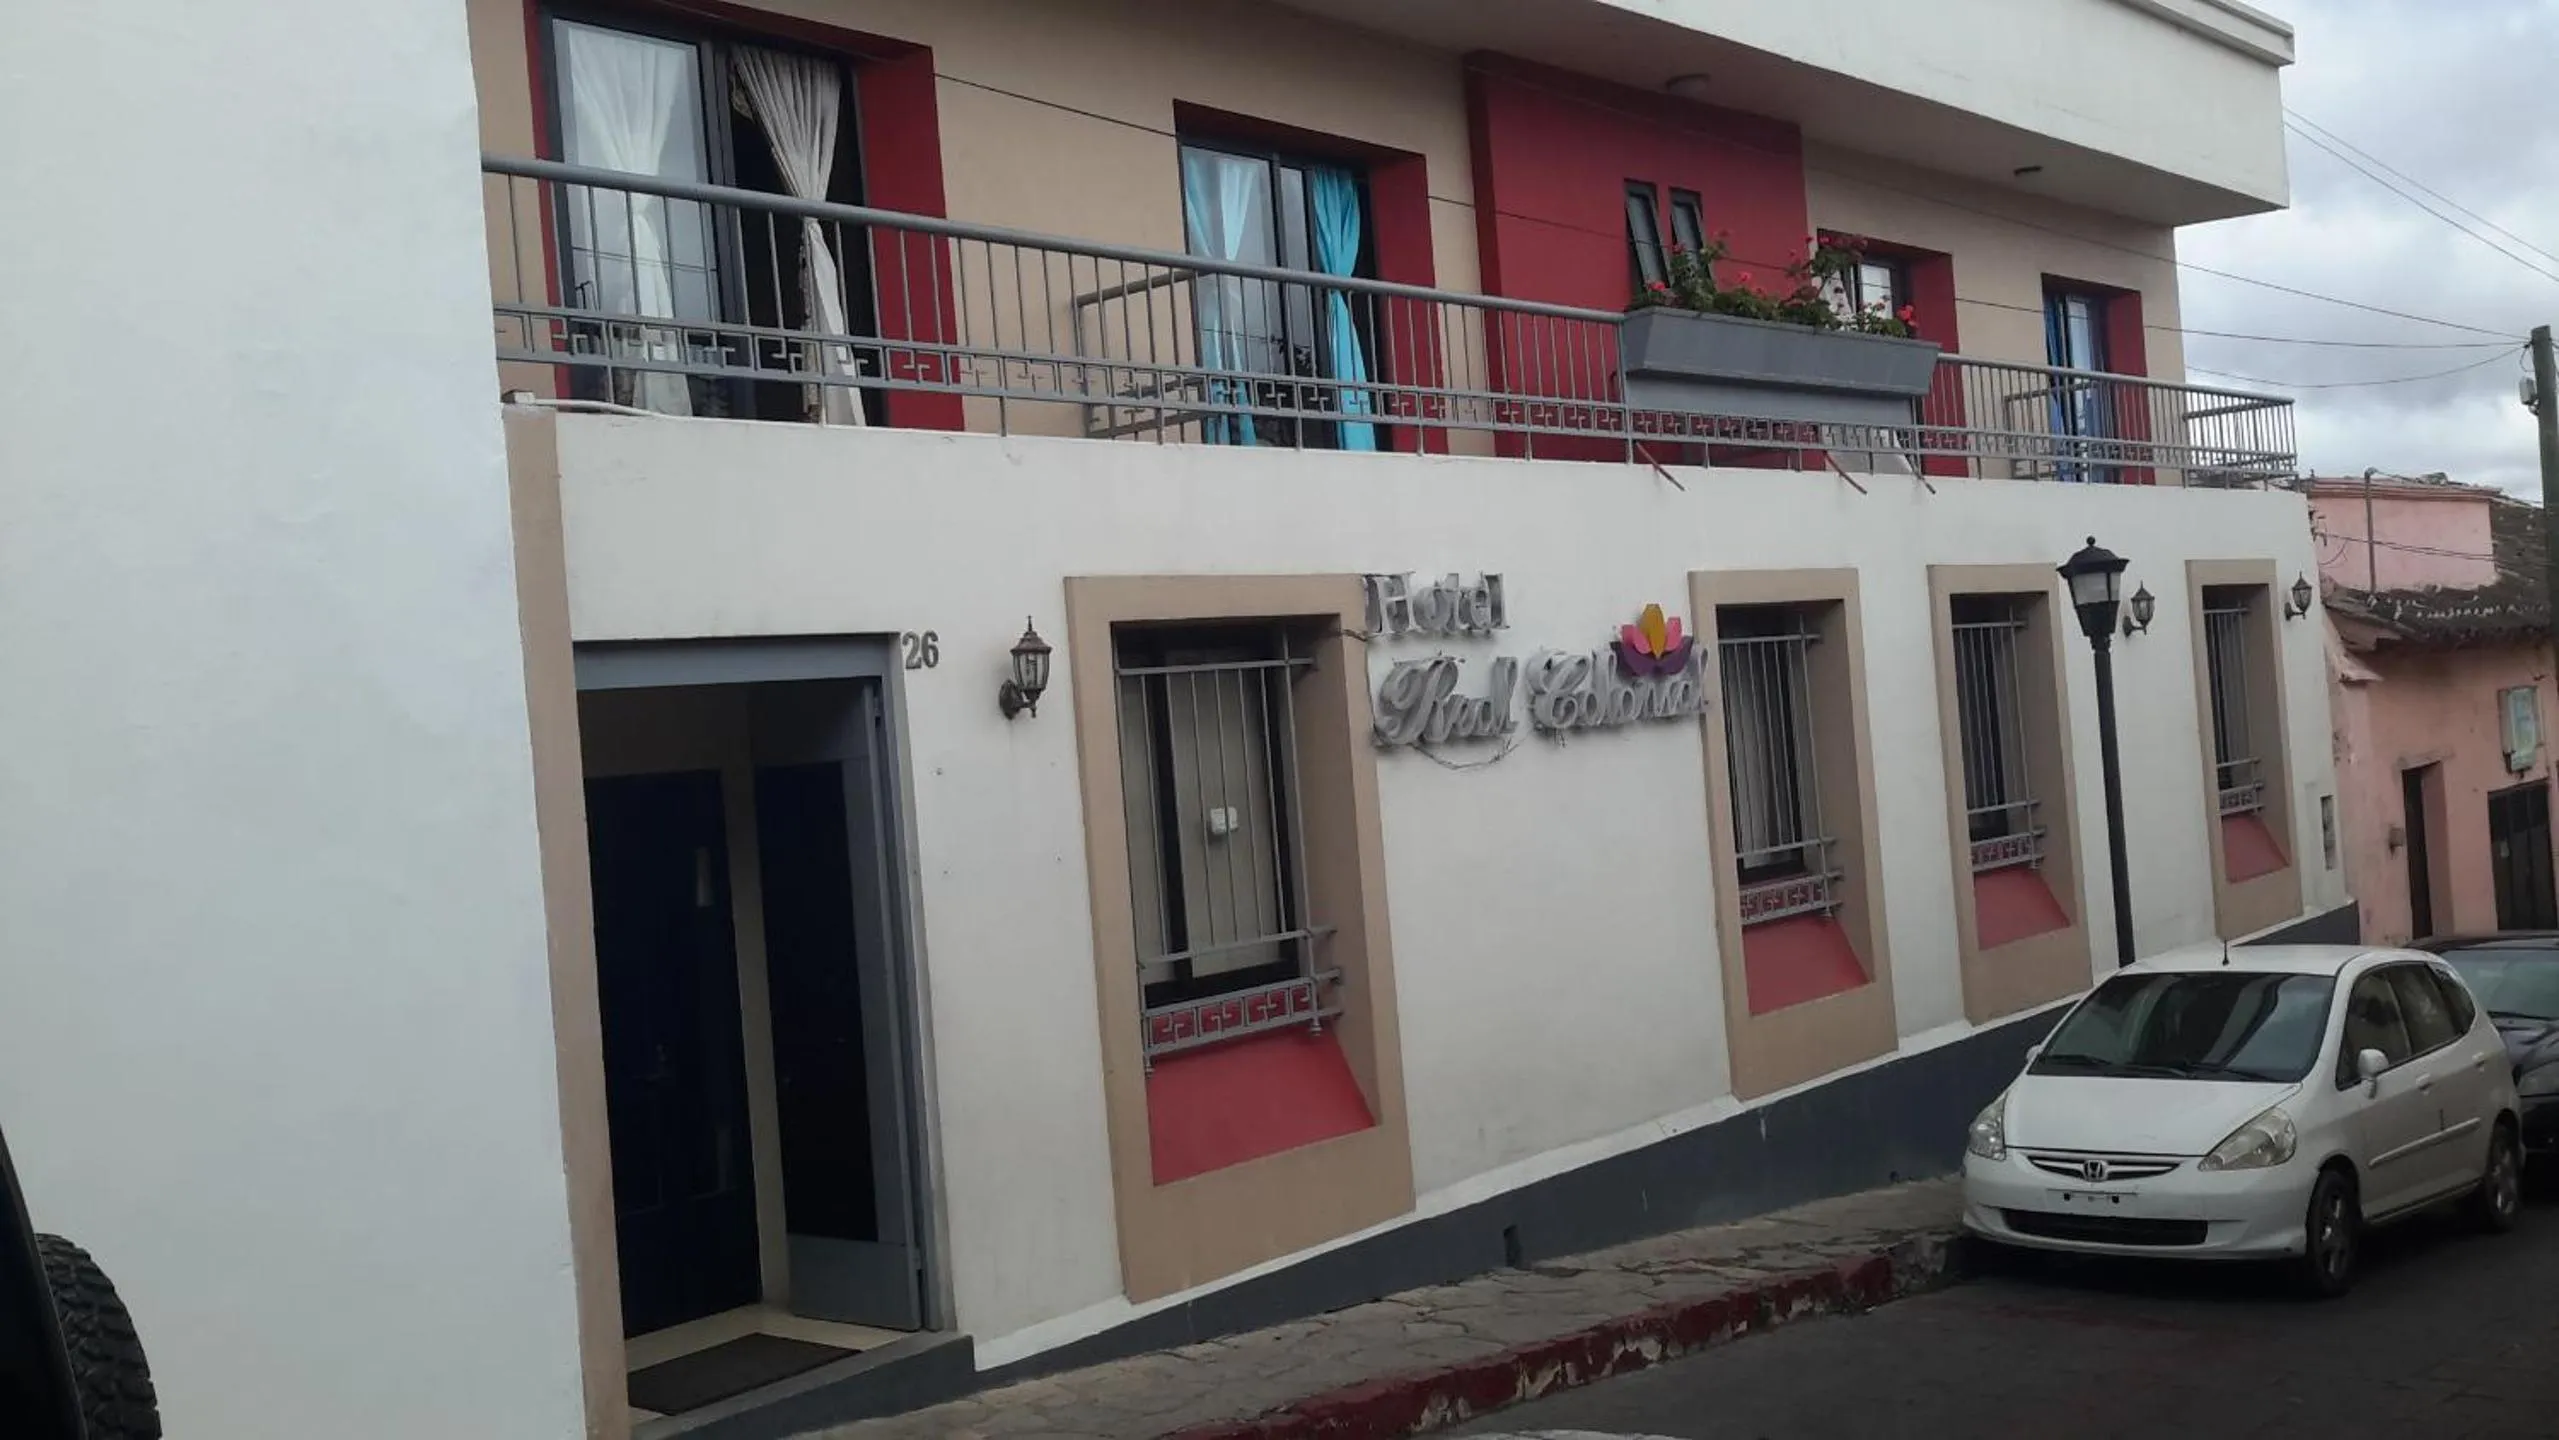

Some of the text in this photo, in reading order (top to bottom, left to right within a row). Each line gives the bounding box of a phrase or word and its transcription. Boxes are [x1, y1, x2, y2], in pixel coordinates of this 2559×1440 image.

[1364, 572, 1510, 634] Hotel
[902, 630, 939, 670] 26
[1377, 647, 1710, 743] Real Colonial
